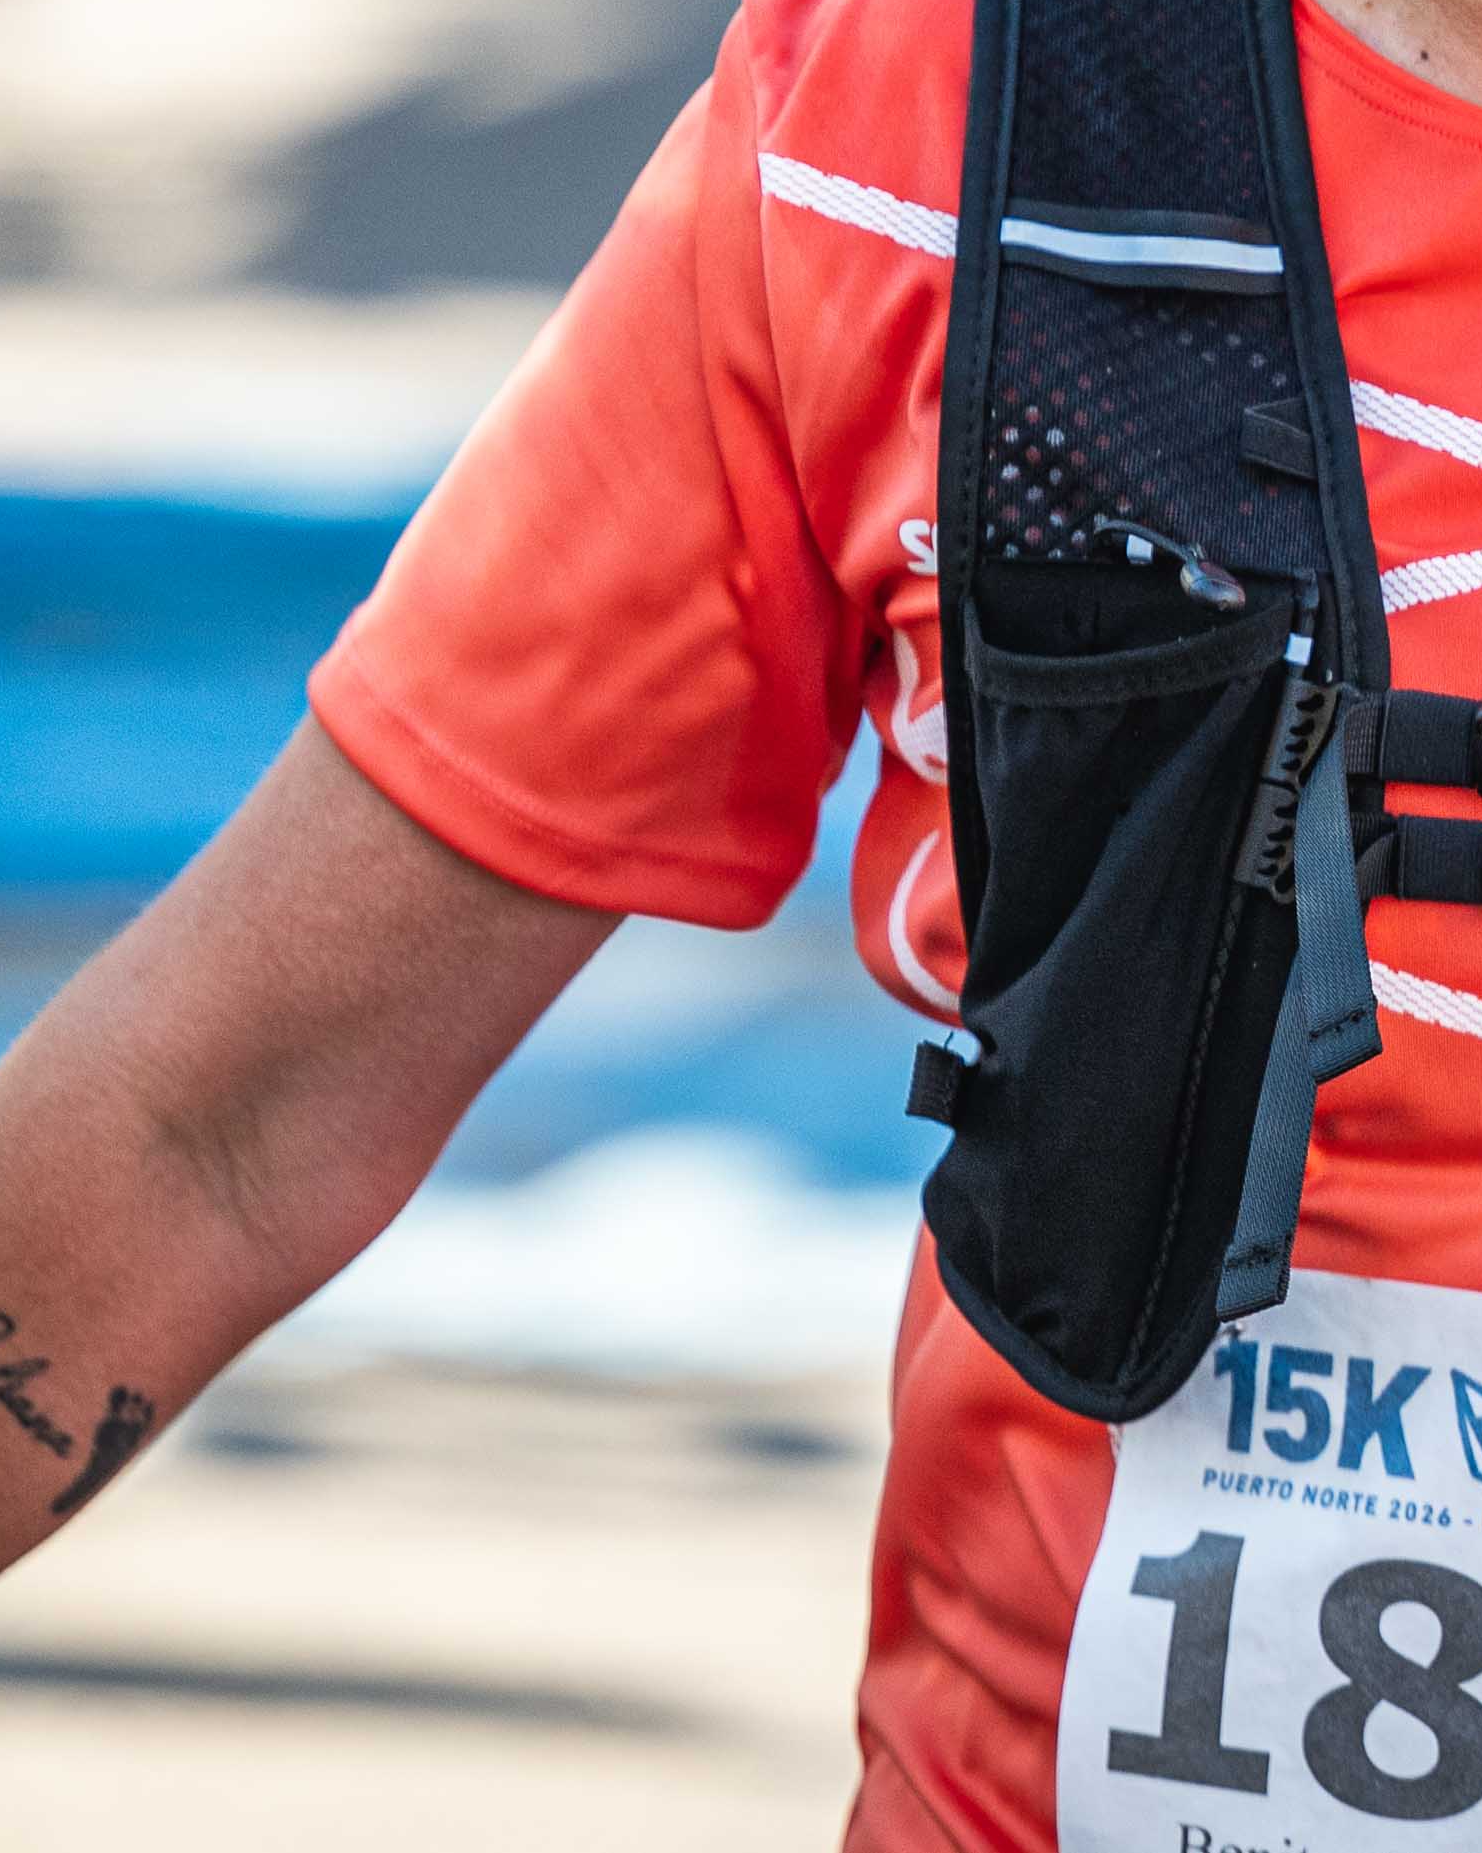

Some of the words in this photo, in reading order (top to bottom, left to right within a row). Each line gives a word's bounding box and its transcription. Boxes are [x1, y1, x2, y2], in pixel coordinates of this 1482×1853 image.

[1213, 1337, 1433, 1481] 15K
[1202, 1467, 1295, 1500] PUERTO
[1301, 1483, 1379, 1518] NORTE
[1388, 1498, 1453, 1528] 2026
